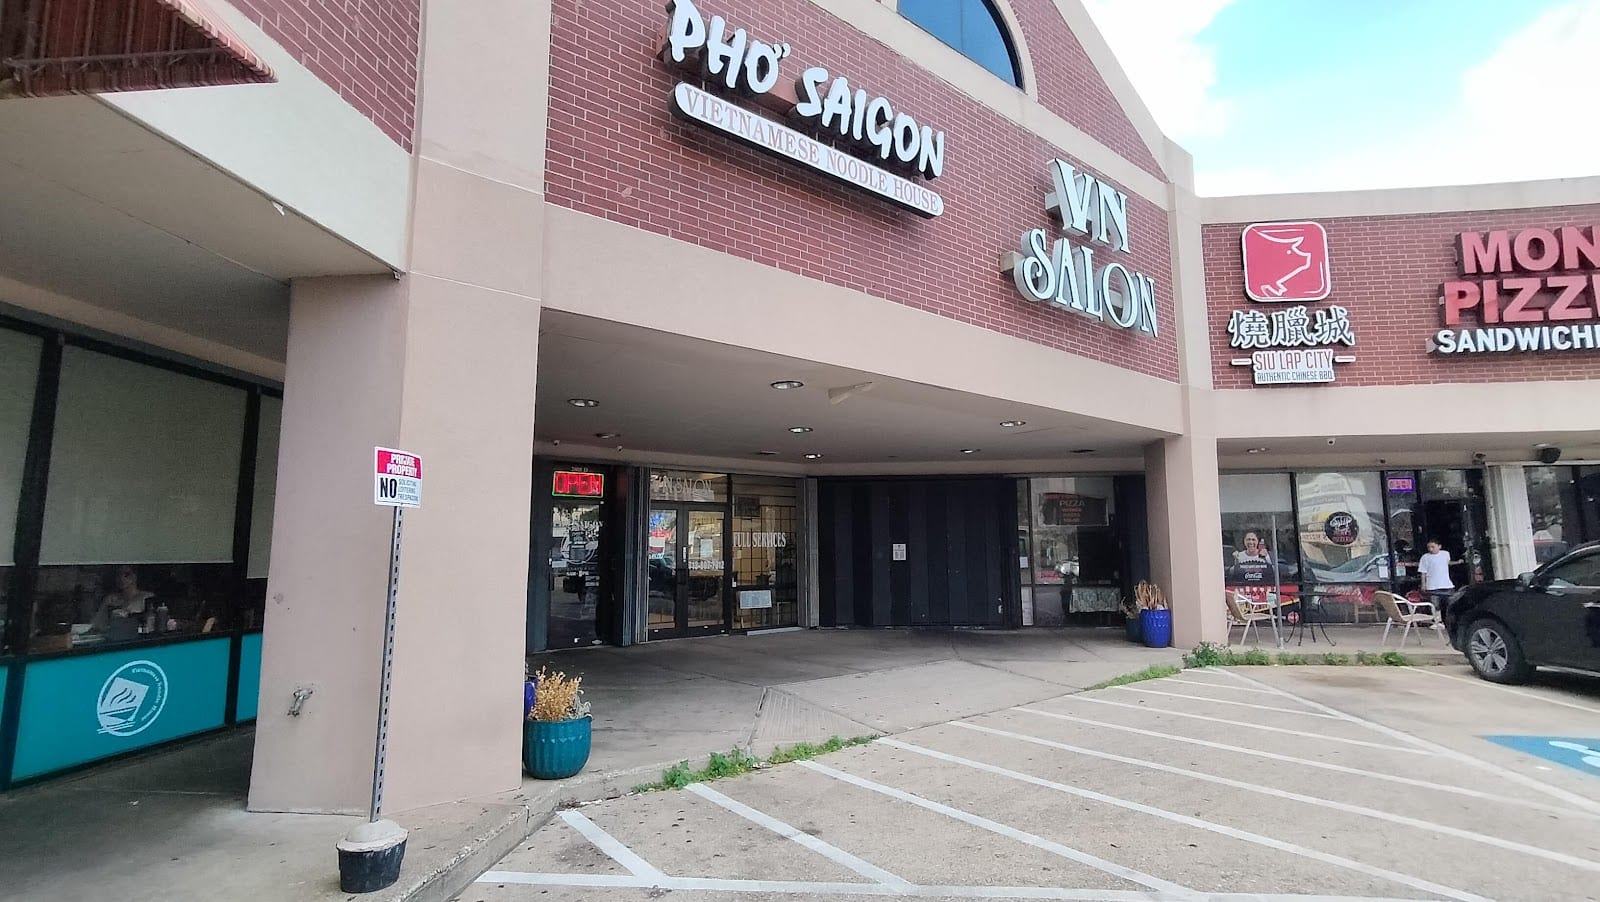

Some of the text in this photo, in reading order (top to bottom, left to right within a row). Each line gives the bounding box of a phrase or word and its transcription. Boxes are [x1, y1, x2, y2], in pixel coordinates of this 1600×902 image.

[796, 67, 945, 176] SAIGON
[685, 87, 939, 212] VIETNAMESE NOODLE HOUSE
[1049, 158, 1131, 254] VN
[1016, 228, 1158, 338] SALON
[1444, 274, 1600, 325] PIZZ
[1228, 305, 1355, 348] 燒臘城
[1437, 324, 1600, 353] SANDWICH
[1255, 351, 1331, 370] SIU LAP CITY
[1257, 372, 1291, 382] AUTHENTIC
[1292, 371, 1317, 380] CHINESE
[386, 463, 417, 477] PROPERTY
[555, 473, 602, 495] OPEN
[379, 477, 398, 499] NO
[752, 532, 787, 548] SERVICES
